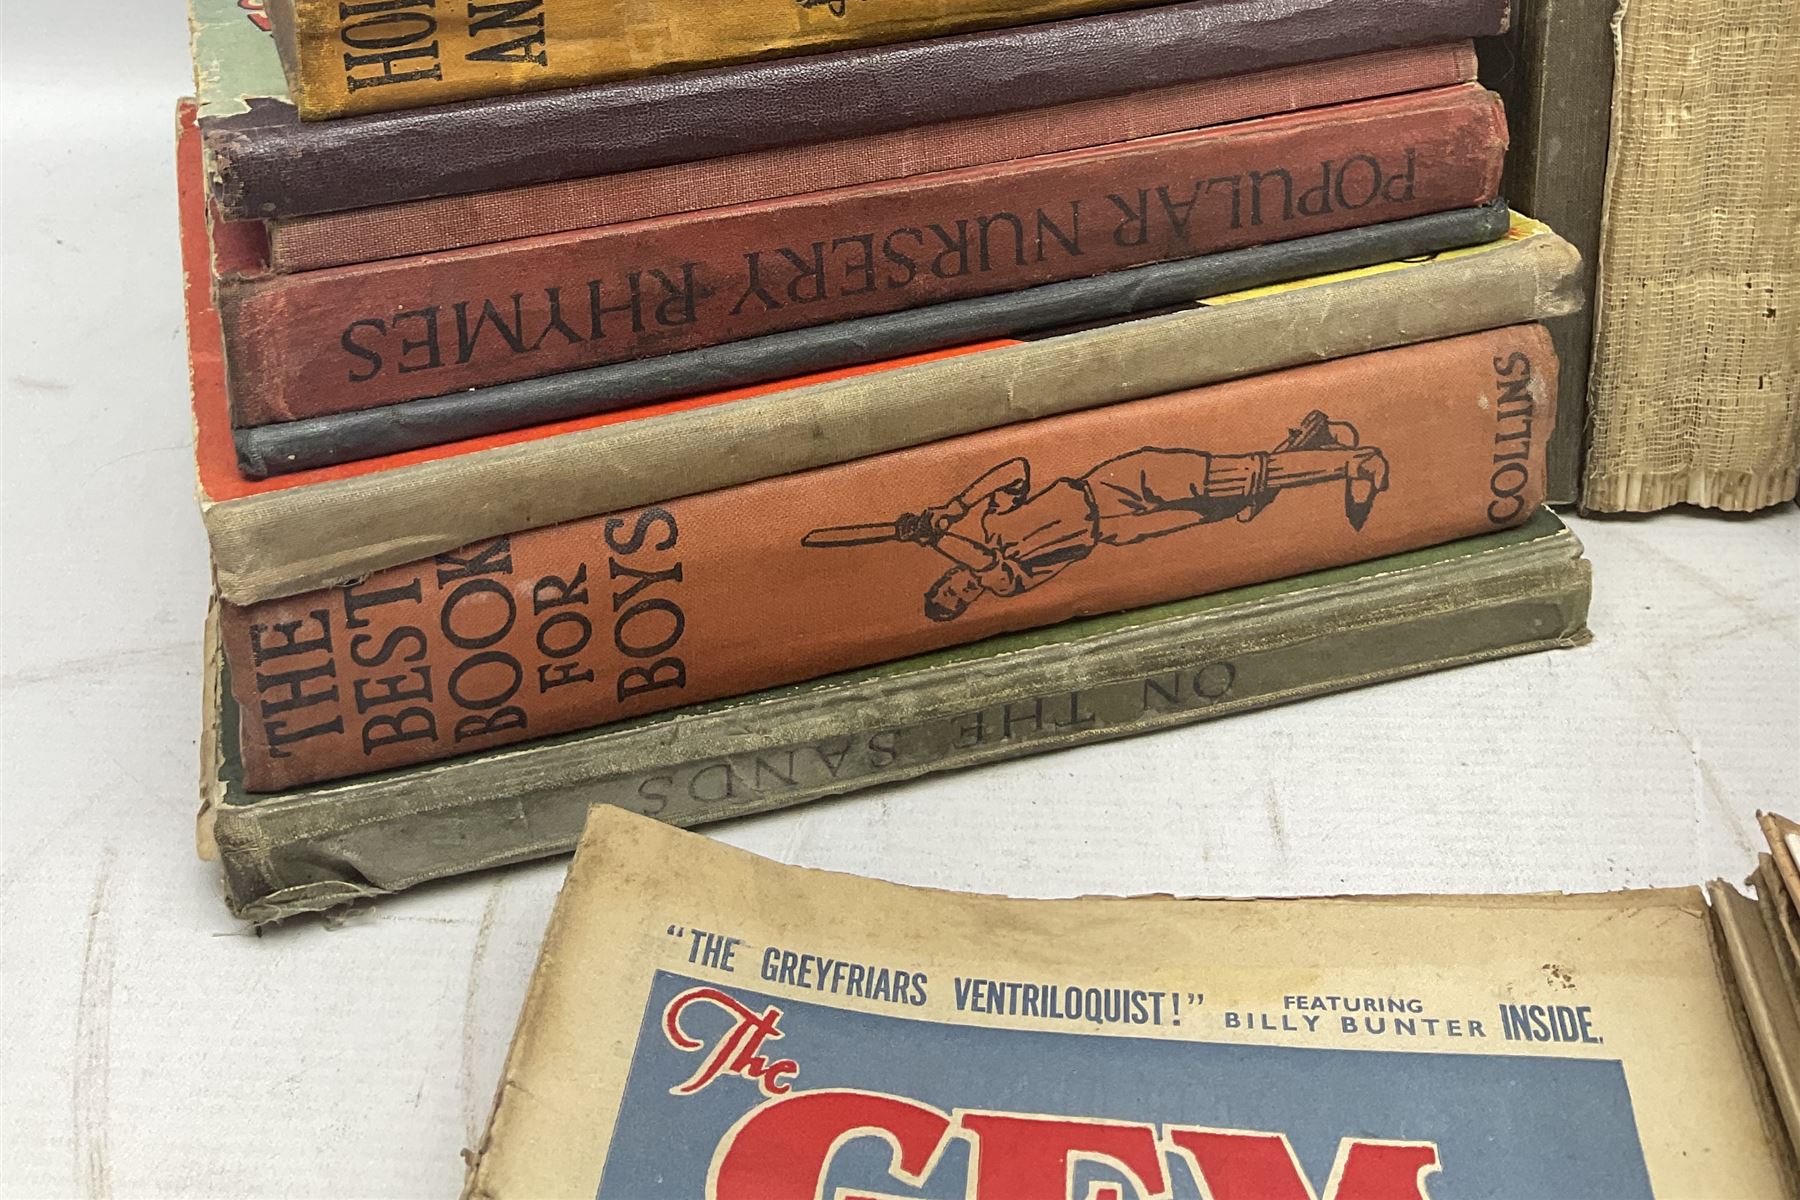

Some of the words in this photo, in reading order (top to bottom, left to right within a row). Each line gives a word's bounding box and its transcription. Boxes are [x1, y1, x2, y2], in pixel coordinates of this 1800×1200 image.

[1106, 147, 1417, 248] POPULAR
[729, 200, 1085, 317] NURSERY
[340, 261, 710, 384] RHYMES
[1487, 351, 1535, 525] COLLINS
[434, 534, 528, 744] BOOK
[532, 561, 596, 694] FOR
[604, 506, 688, 703] BOYS
[249, 608, 345, 759] THE
[343, 576, 439, 756] BEST
[950, 690, 1098, 751] THE
[1138, 660, 1238, 711] ON
[636, 729, 900, 816] SANDS
[760, 946, 928, 1008] GREYFRIARS
[1223, 1011, 1321, 1033] BILLY
[1340, 1015, 1488, 1038] BUNTER
[1283, 995, 1425, 1015] FEATURING
[1498, 1003, 1605, 1045] INSIDE.
[663, 987, 800, 1097] The
